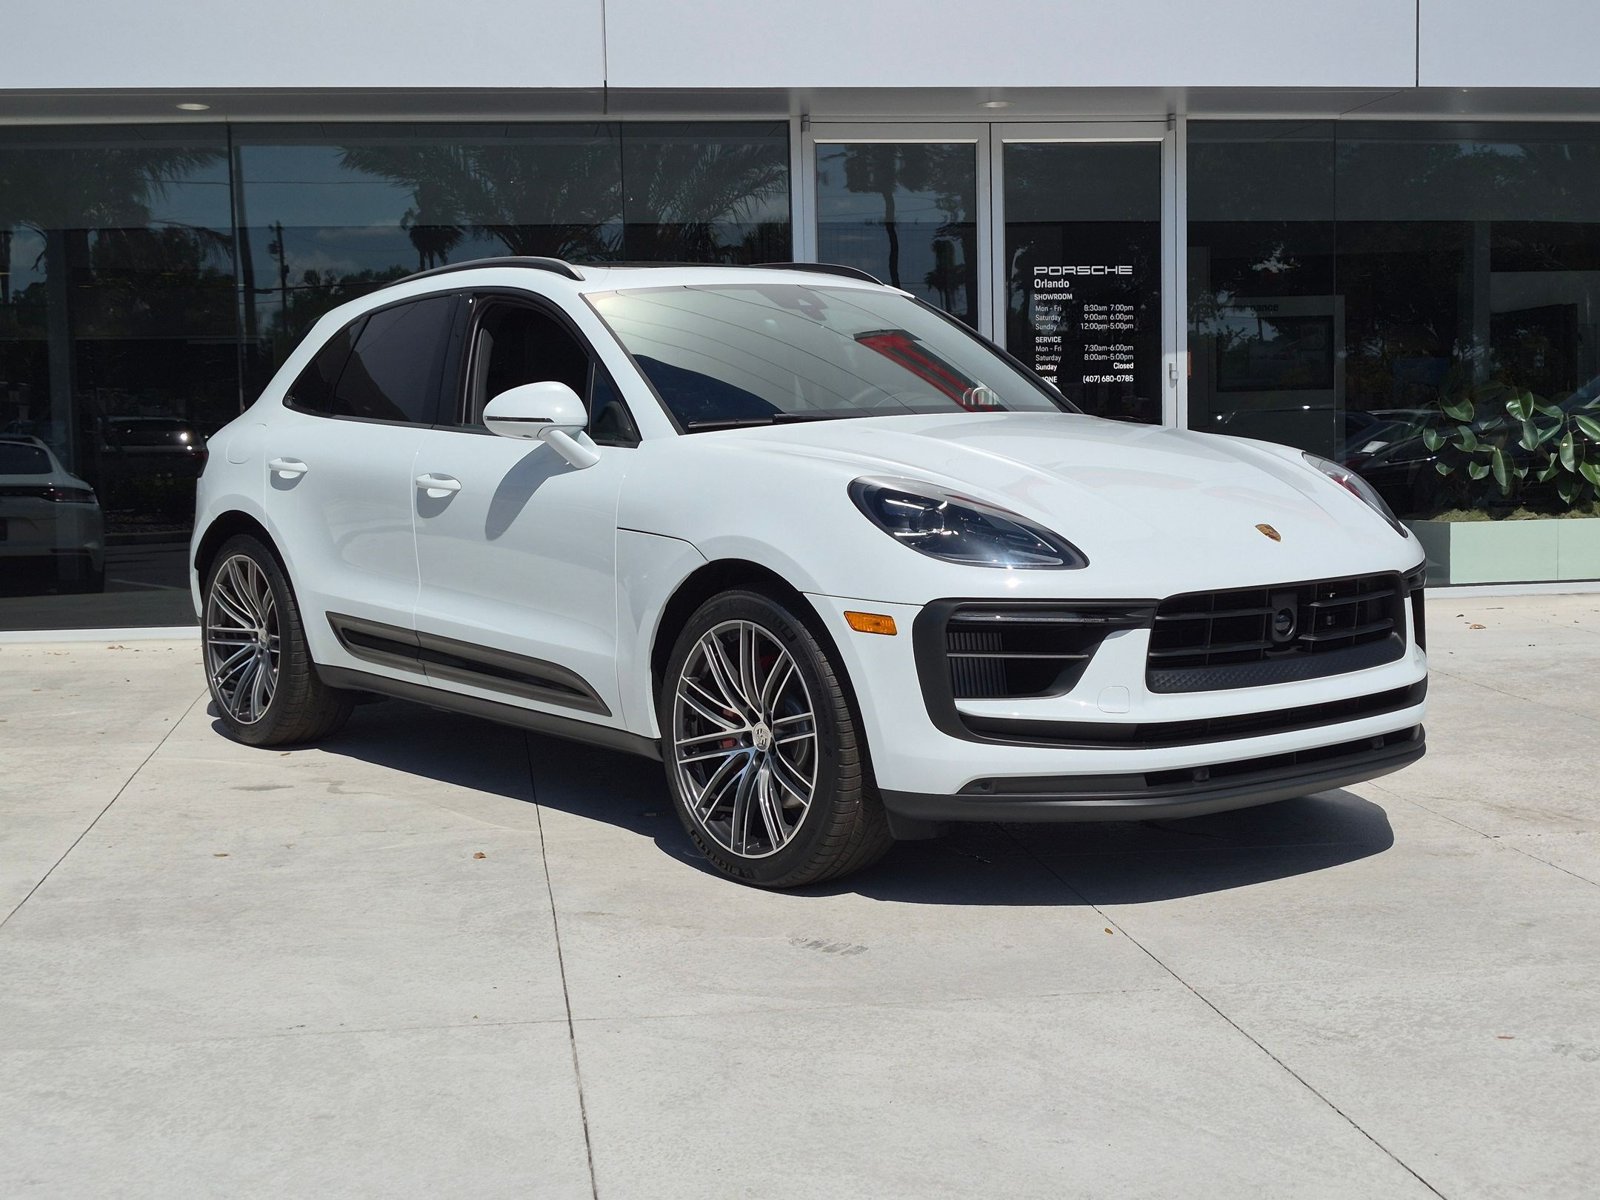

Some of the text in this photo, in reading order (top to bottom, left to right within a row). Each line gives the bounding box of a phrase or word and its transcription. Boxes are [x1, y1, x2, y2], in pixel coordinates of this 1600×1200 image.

[1033, 265, 1133, 276] PORSCHE
[1034, 278, 1070, 288] Orlando
[1034, 293, 1073, 301] SHOWROOM
[1054, 304, 1062, 312] Fri
[1035, 314, 1061, 322] Saturday
[1035, 323, 1057, 332] Sunday
[1035, 354, 1061, 363] Saturday
[1035, 362, 1134, 371] Sunday Closed
[1082, 375, 1101, 384] (407)
[1101, 374, 1134, 383] 680-0785
